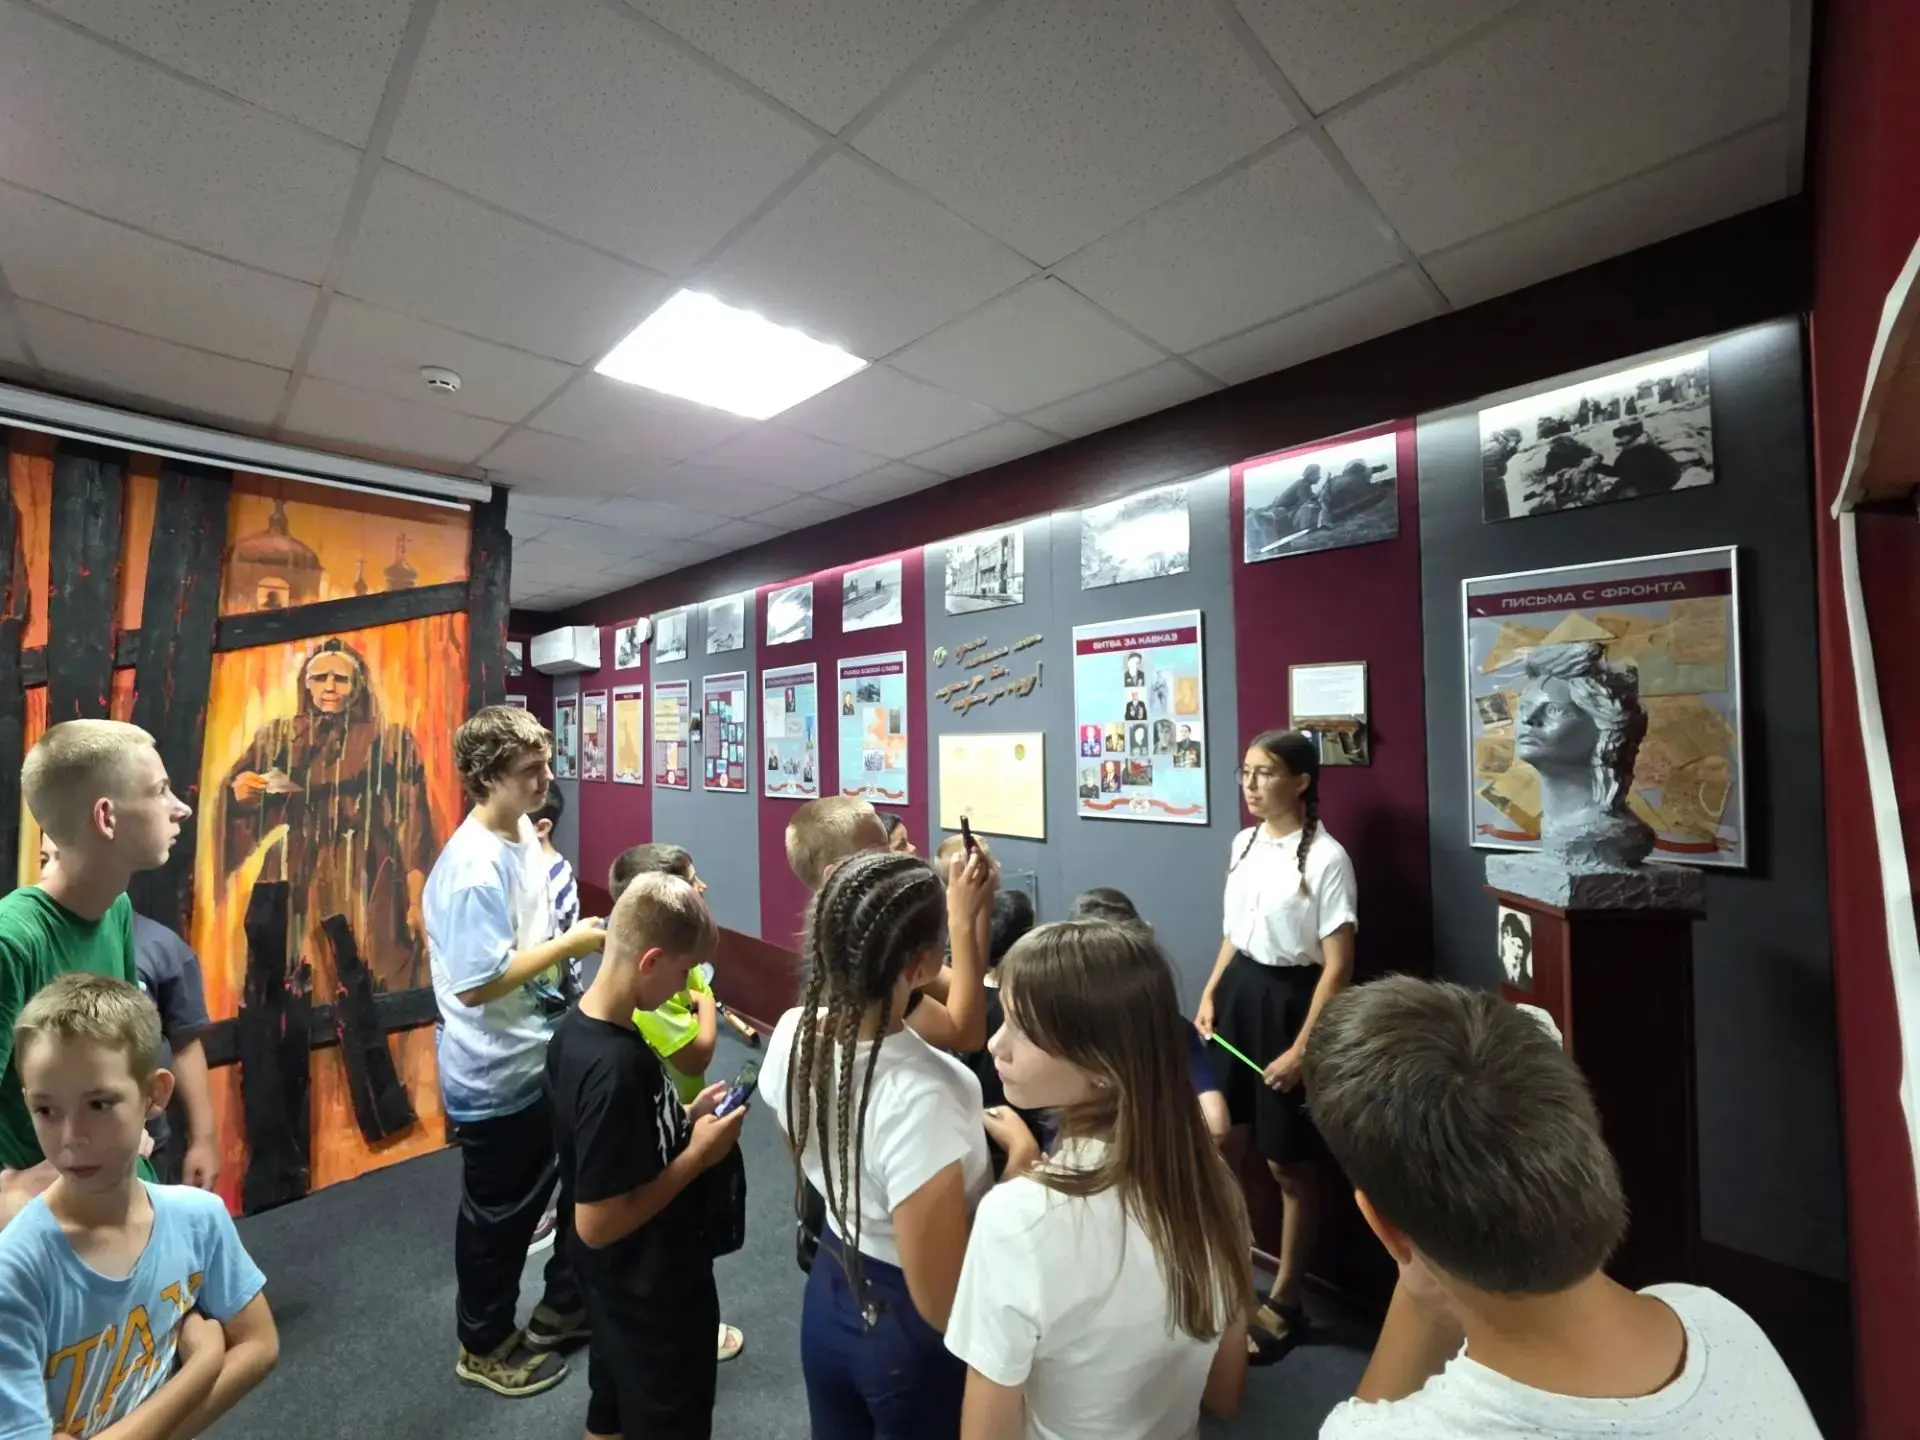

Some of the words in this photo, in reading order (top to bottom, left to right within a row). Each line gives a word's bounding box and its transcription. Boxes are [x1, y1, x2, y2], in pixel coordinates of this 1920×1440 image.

[1502, 592, 1576, 609] ПИСЬМА
[1582, 590, 1595, 601] С
[1601, 580, 1686, 598] ФРОНТА
[1093, 639, 1122, 650] БИТВА
[1124, 637, 1137, 647] ЗА
[1138, 632, 1178, 645] КАВКАЗ
